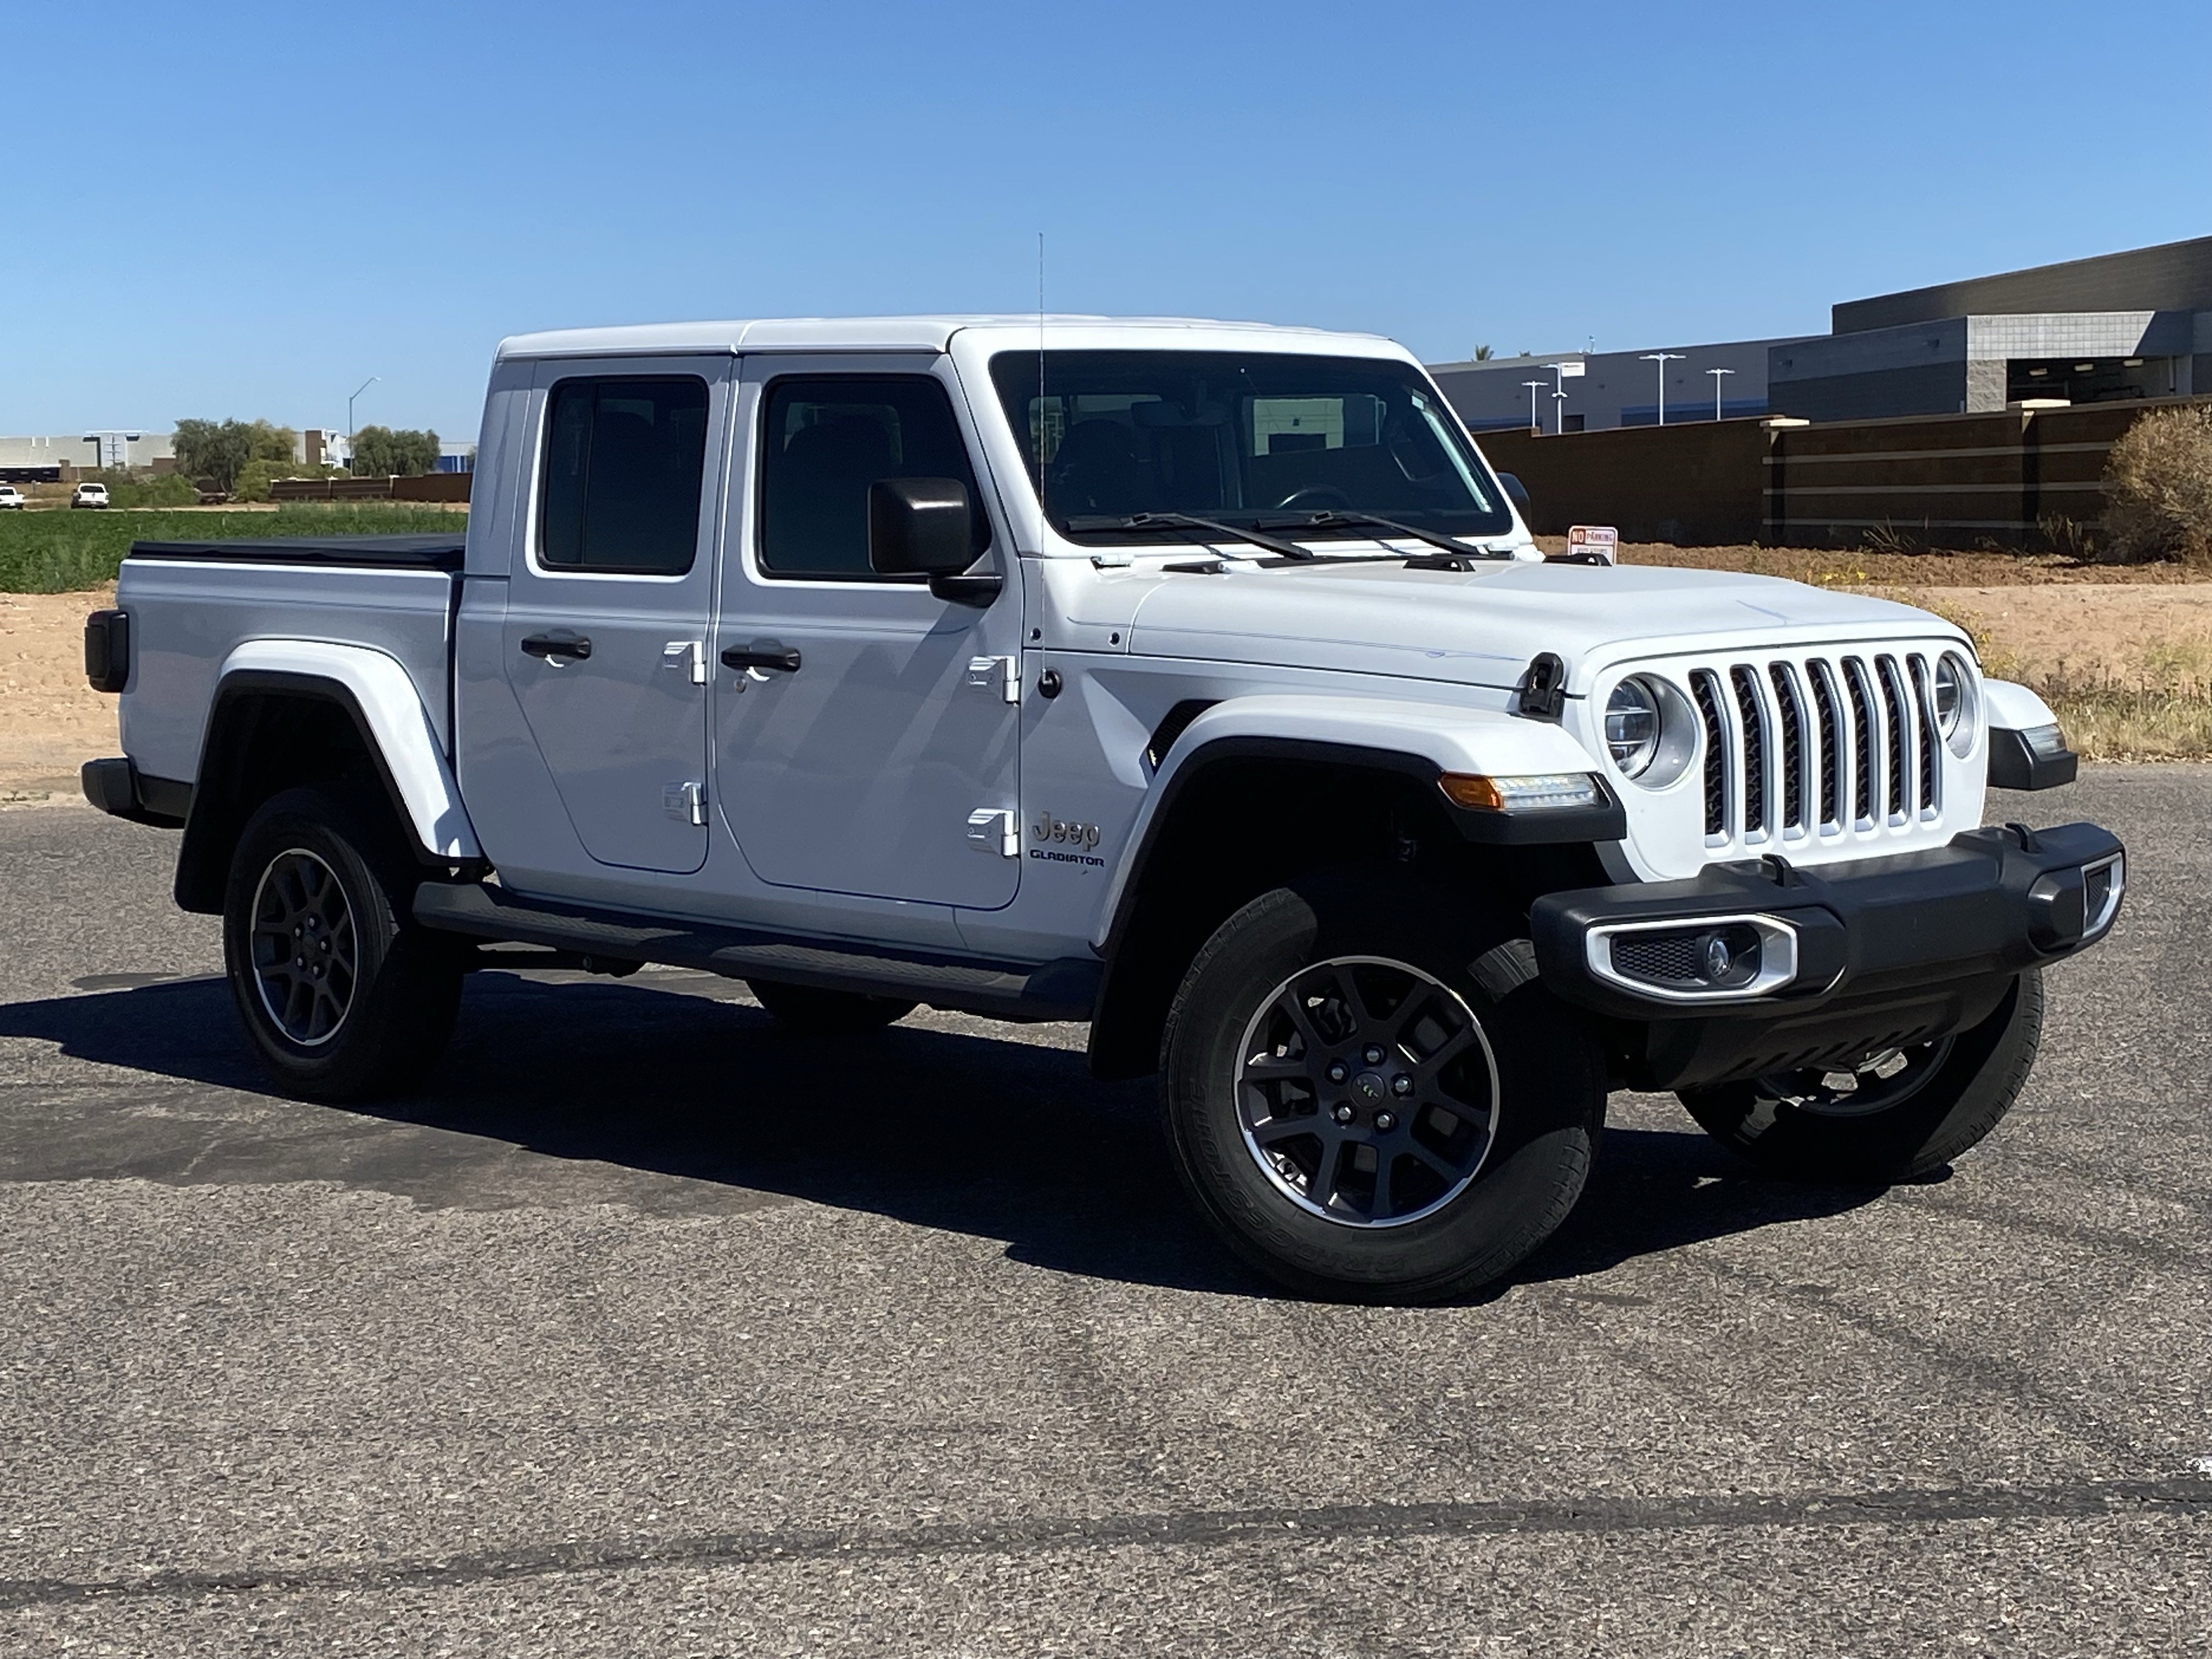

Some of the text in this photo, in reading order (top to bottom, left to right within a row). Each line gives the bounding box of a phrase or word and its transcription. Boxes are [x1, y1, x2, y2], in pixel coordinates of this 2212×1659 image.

[1572, 531, 1584, 543] NO
[1032, 810, 1101, 852] Jeep
[1030, 849, 1104, 867] GLADIATOR
[1189, 1079, 1406, 1276] BRIDGESTONE
